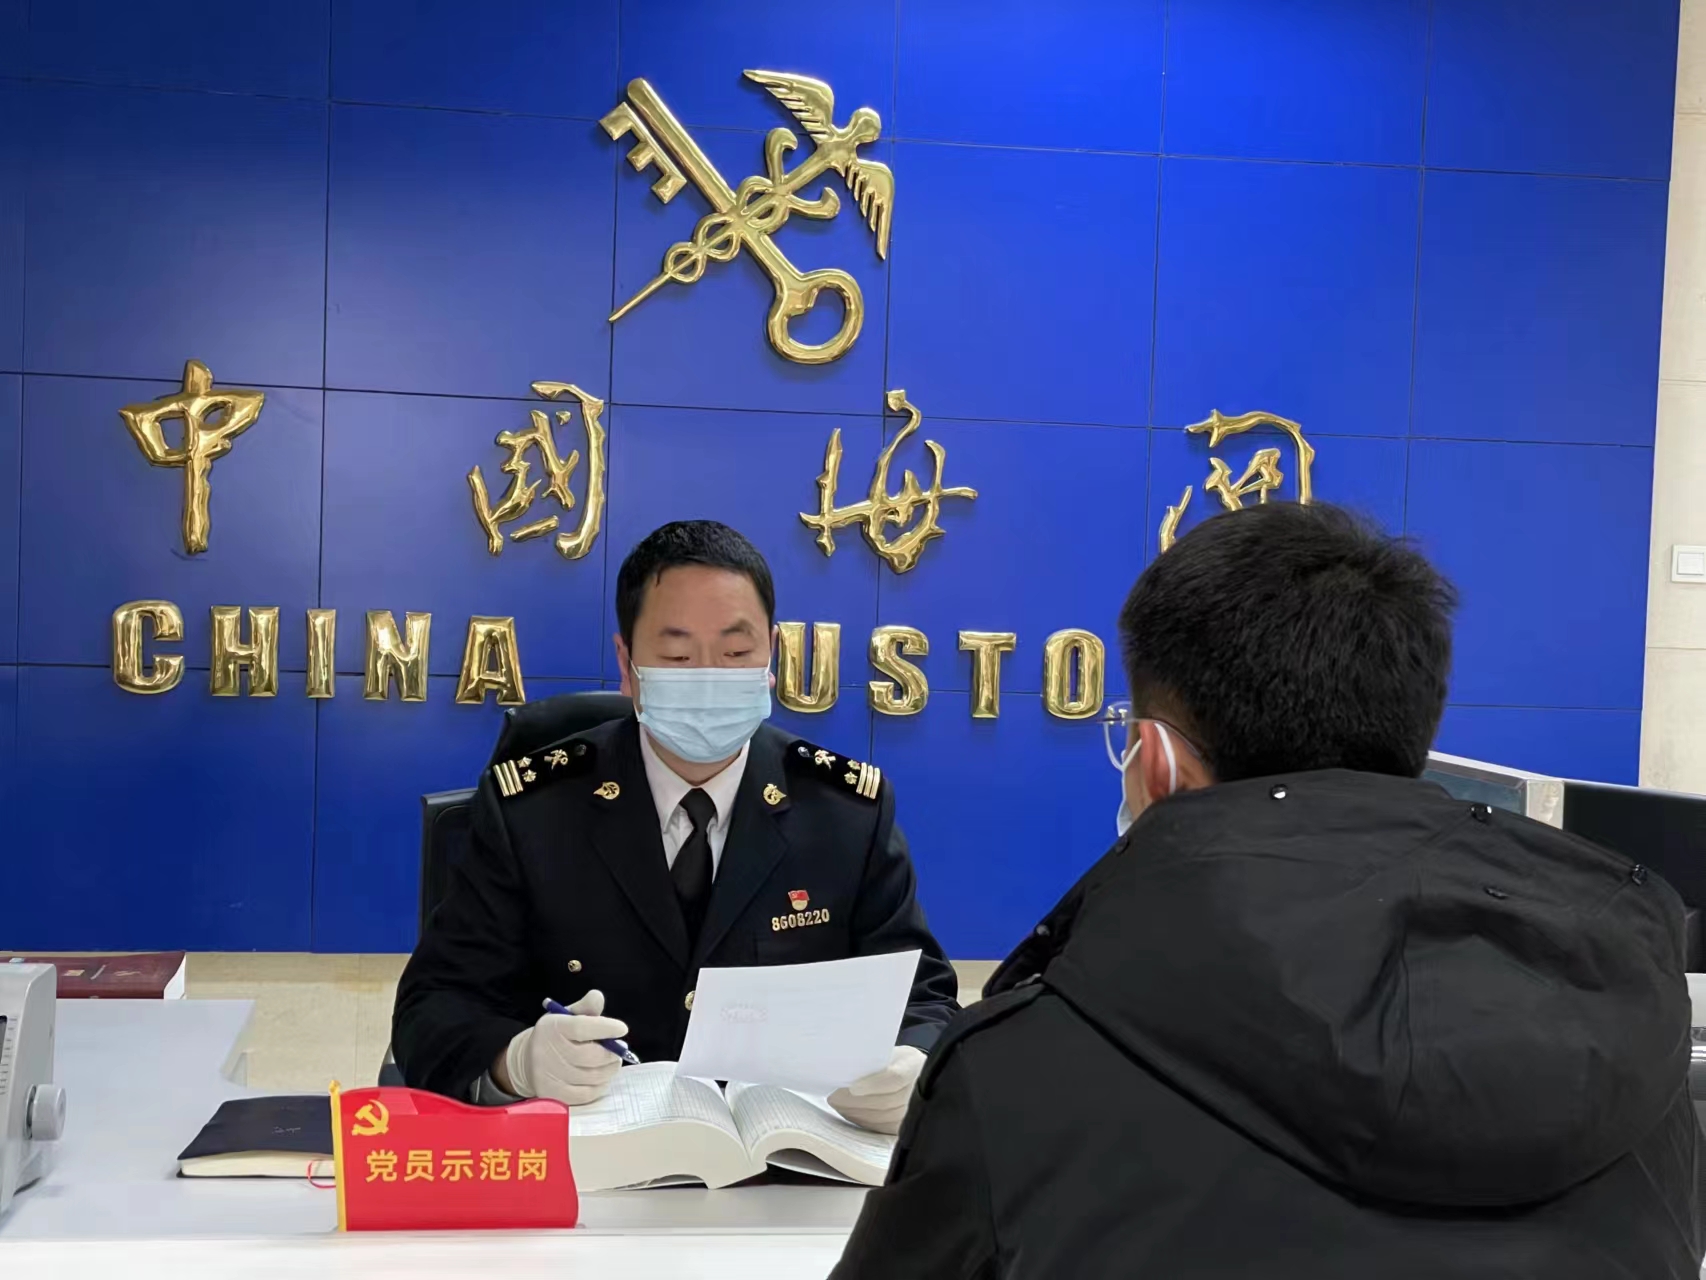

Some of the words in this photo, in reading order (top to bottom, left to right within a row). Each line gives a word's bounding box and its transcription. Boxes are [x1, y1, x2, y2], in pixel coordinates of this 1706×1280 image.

[112, 600, 526, 705] CHINA
[776, 621, 1105, 720] USTO
[771, 908, 831, 931] 8608220
[365, 1148, 548, 1183] 党员示范岗
